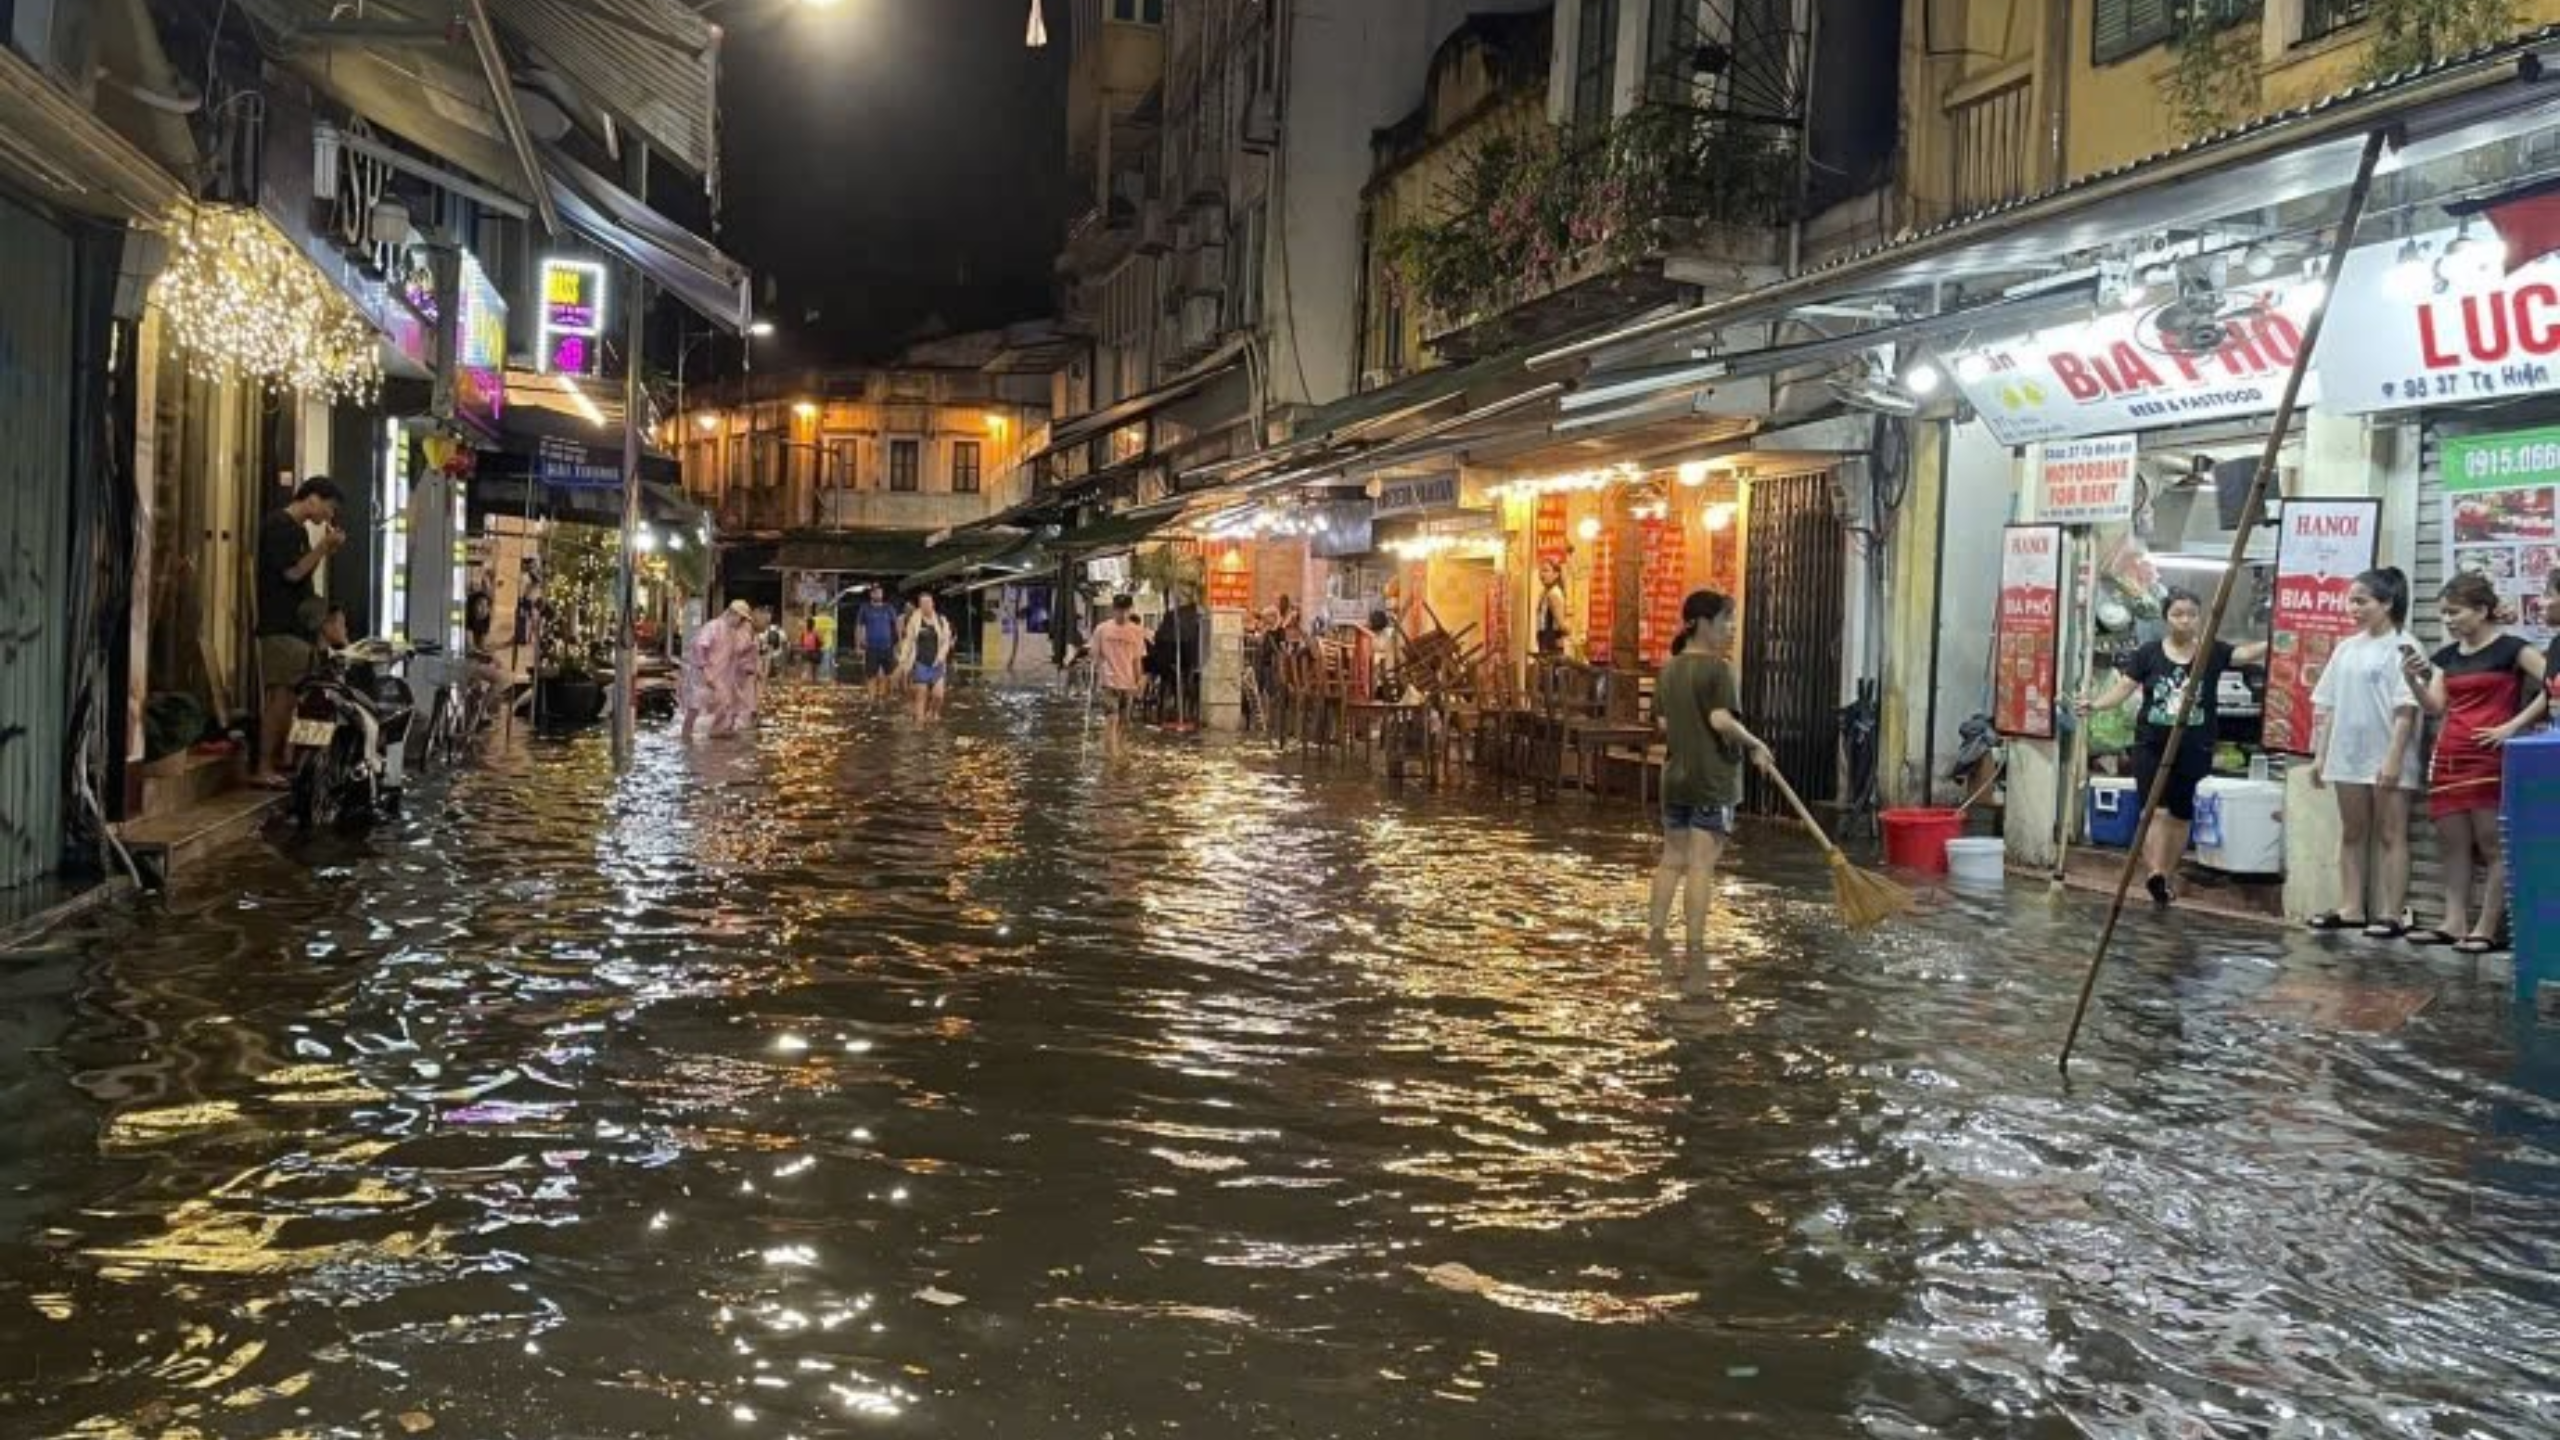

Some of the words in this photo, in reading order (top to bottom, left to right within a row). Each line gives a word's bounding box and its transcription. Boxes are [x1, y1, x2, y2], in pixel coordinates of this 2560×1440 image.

[2437, 373, 2459, 395] 37
[2128, 400, 2167, 417] BEER
[2180, 387, 2262, 410] FASTFOOD
[2045, 460, 2129, 484] MOTORBIKE
[2050, 485, 2077, 506] FOR
[2081, 482, 2118, 504] RENT
[2295, 515, 2360, 537] HANOI
[2012, 536, 2050, 554] HANOI
[2280, 588, 2313, 610] BIA
